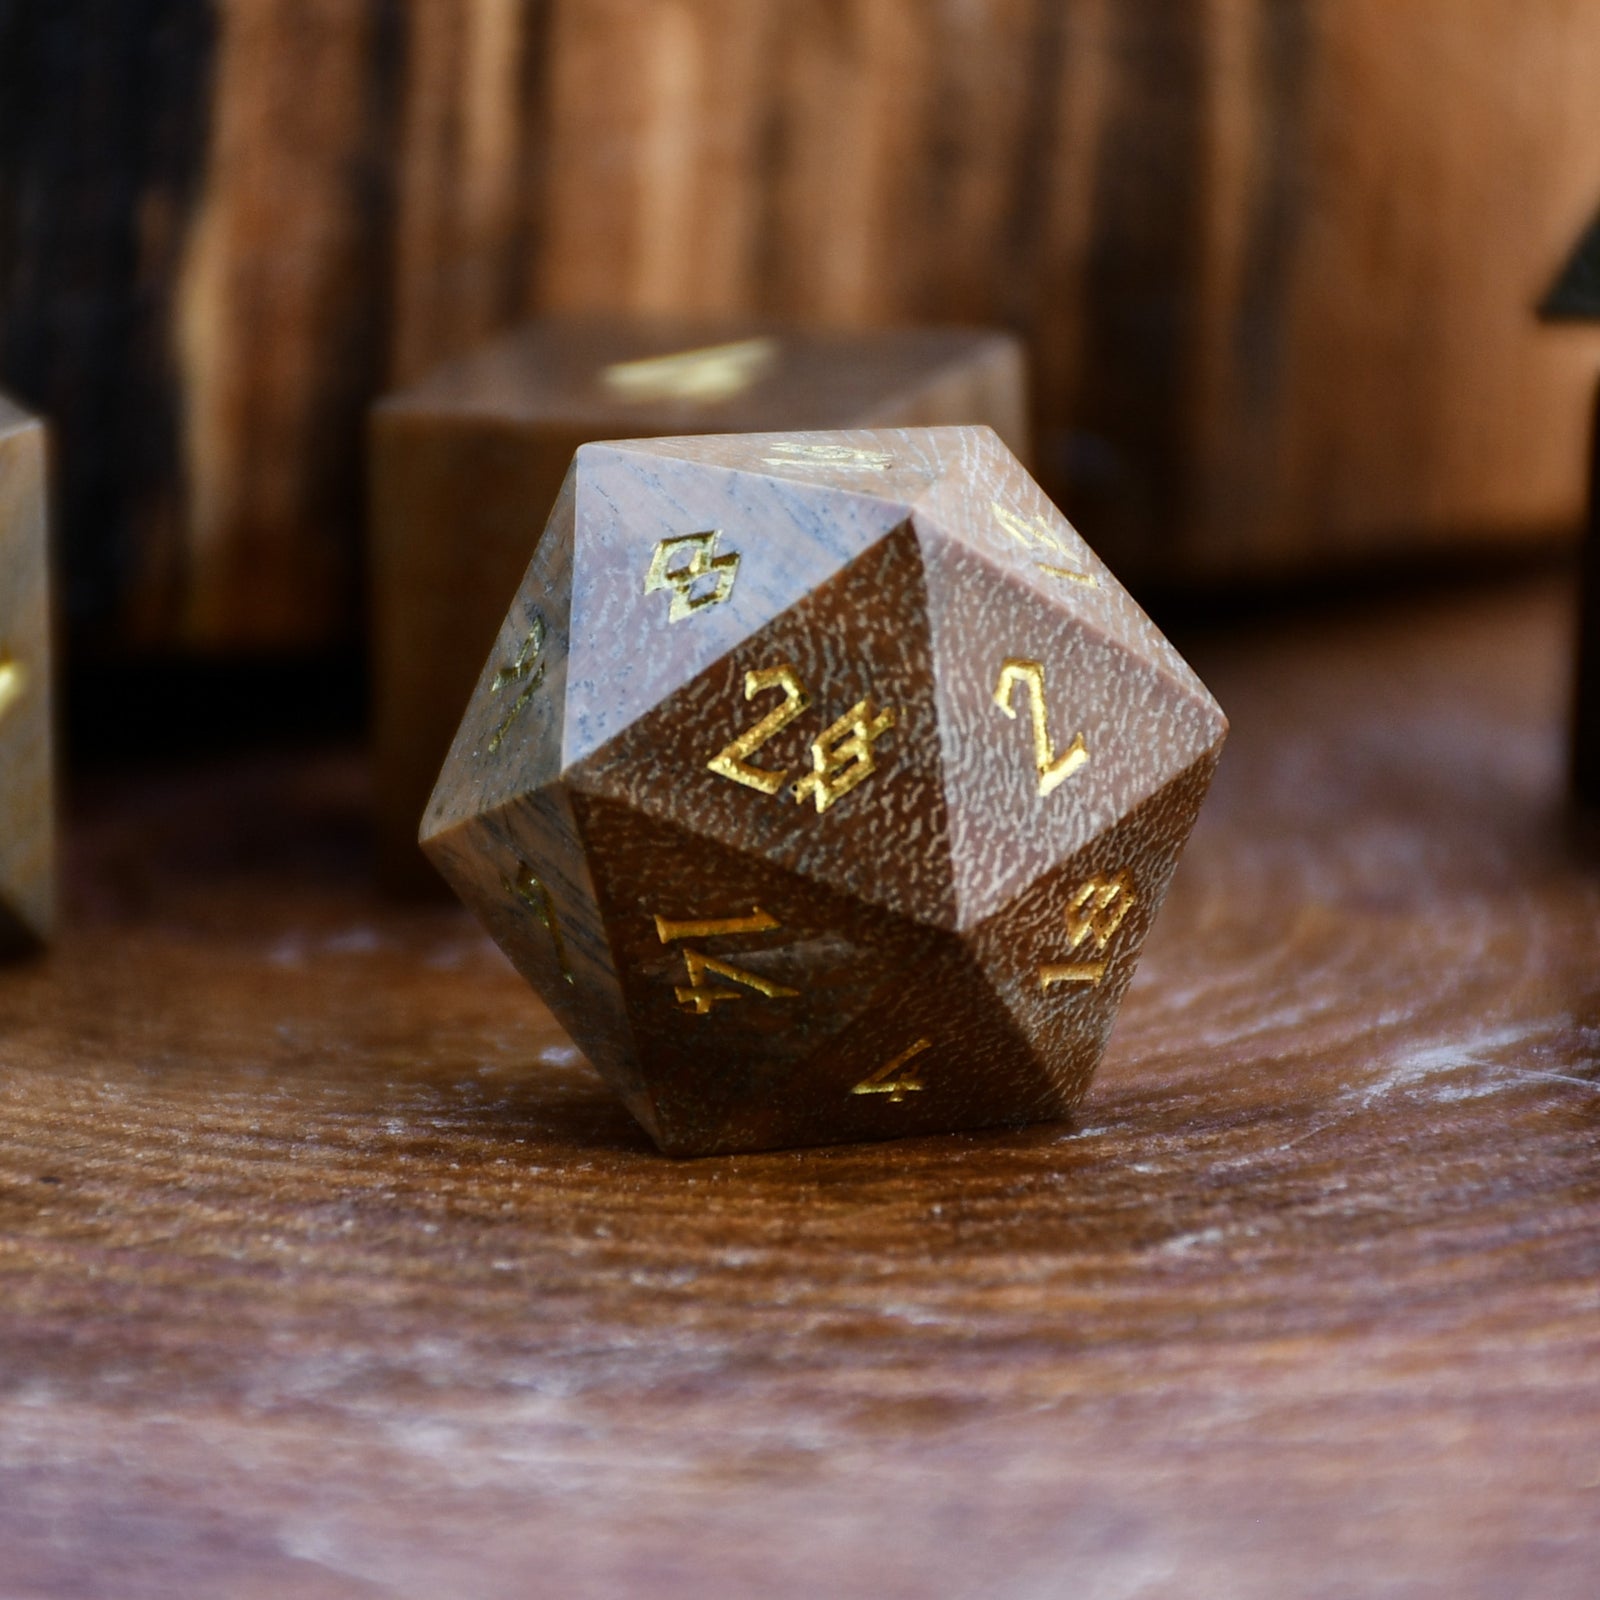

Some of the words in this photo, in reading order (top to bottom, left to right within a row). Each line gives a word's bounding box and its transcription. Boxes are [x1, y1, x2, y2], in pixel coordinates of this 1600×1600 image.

[993, 657, 1090, 797] 2
[653, 905, 800, 1015] 14
[851, 1038, 933, 1103] 4
